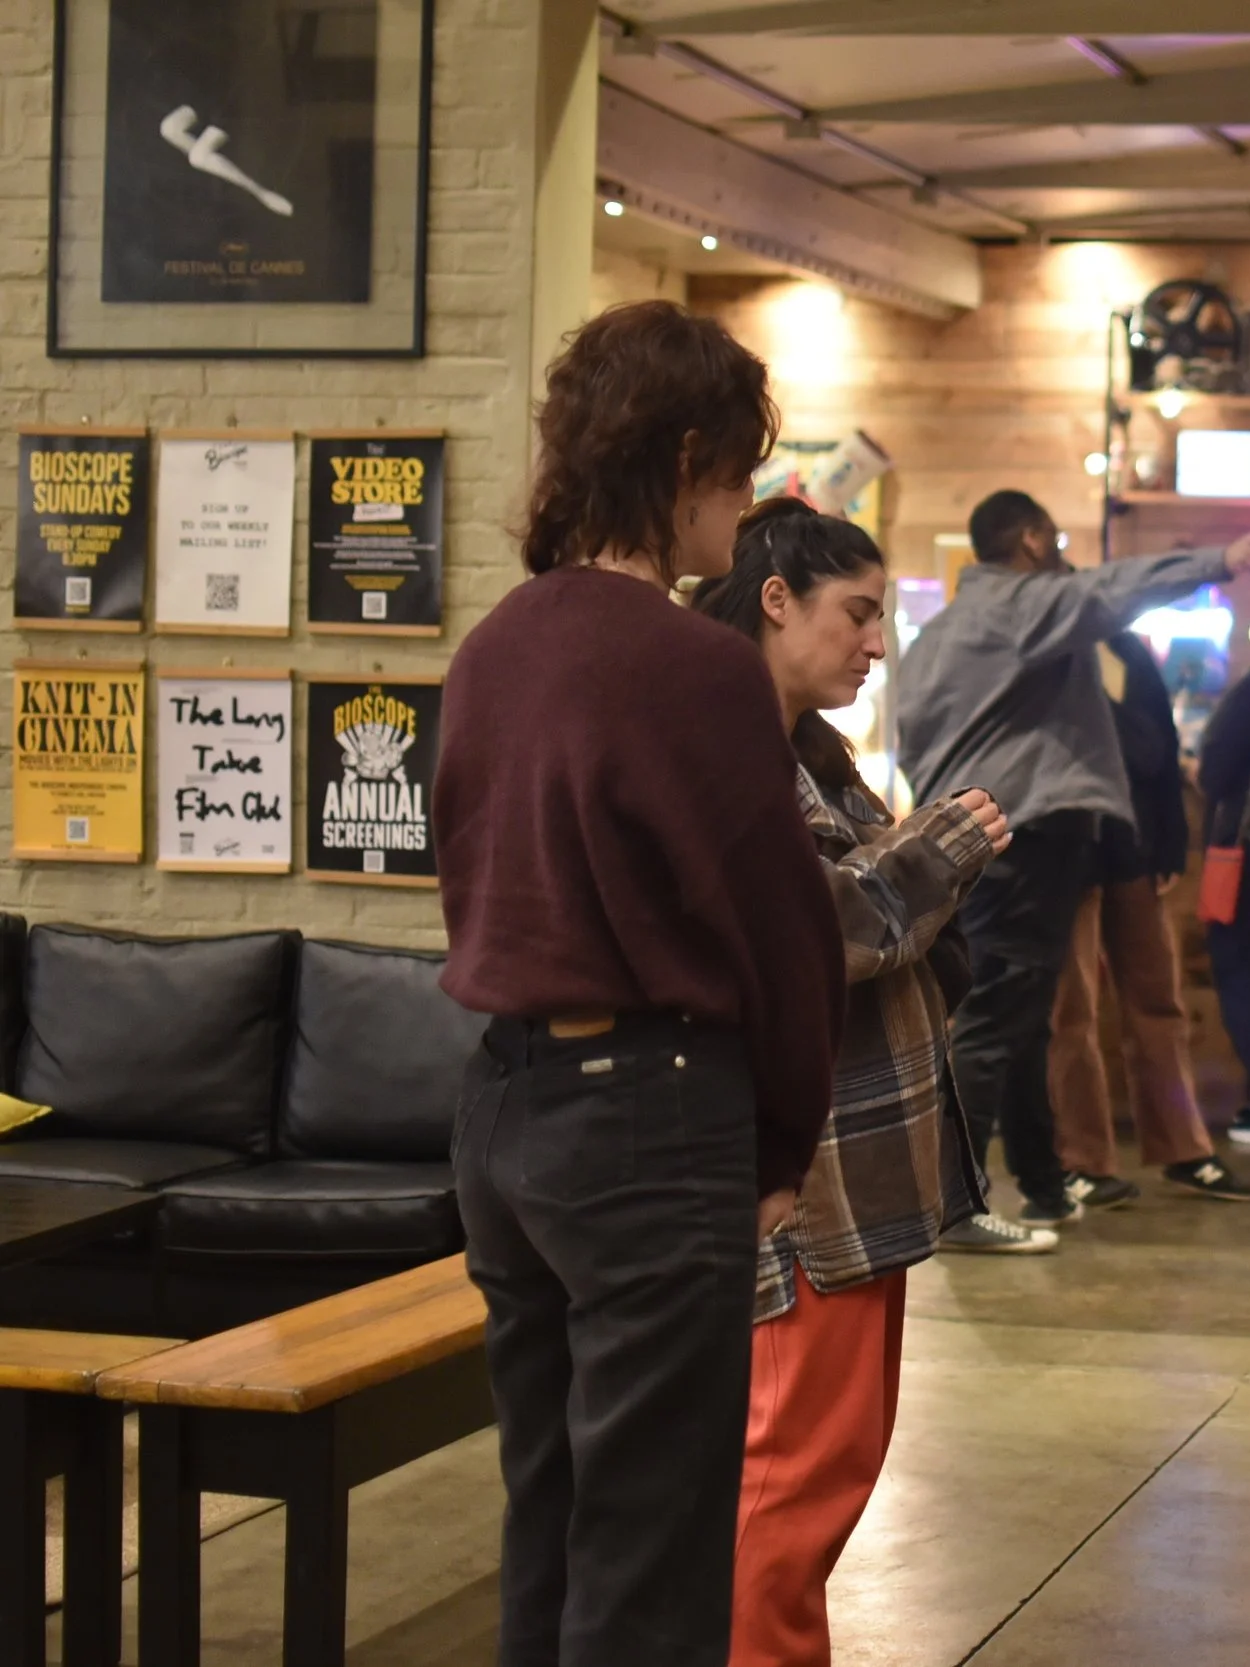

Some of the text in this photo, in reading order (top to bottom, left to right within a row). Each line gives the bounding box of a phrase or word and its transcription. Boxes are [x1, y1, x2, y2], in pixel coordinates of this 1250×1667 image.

[228, 260, 246, 274] DE
[30, 451, 133, 483] BIOSCOPE
[330, 457, 425, 481] VIDEO
[33, 482, 131, 516] SUNDAYS
[331, 481, 423, 504] STORE
[21, 681, 138, 716] KNIT-IN
[333, 694, 417, 737] BIOSCOPE
[18, 717, 136, 754] CINEMA
[169, 695, 286, 743] The Long
[192, 745, 263, 774] Take
[175, 787, 235, 822] Film
[323, 781, 426, 822] ANNUAL
[322, 821, 427, 851] SCREENINGS
